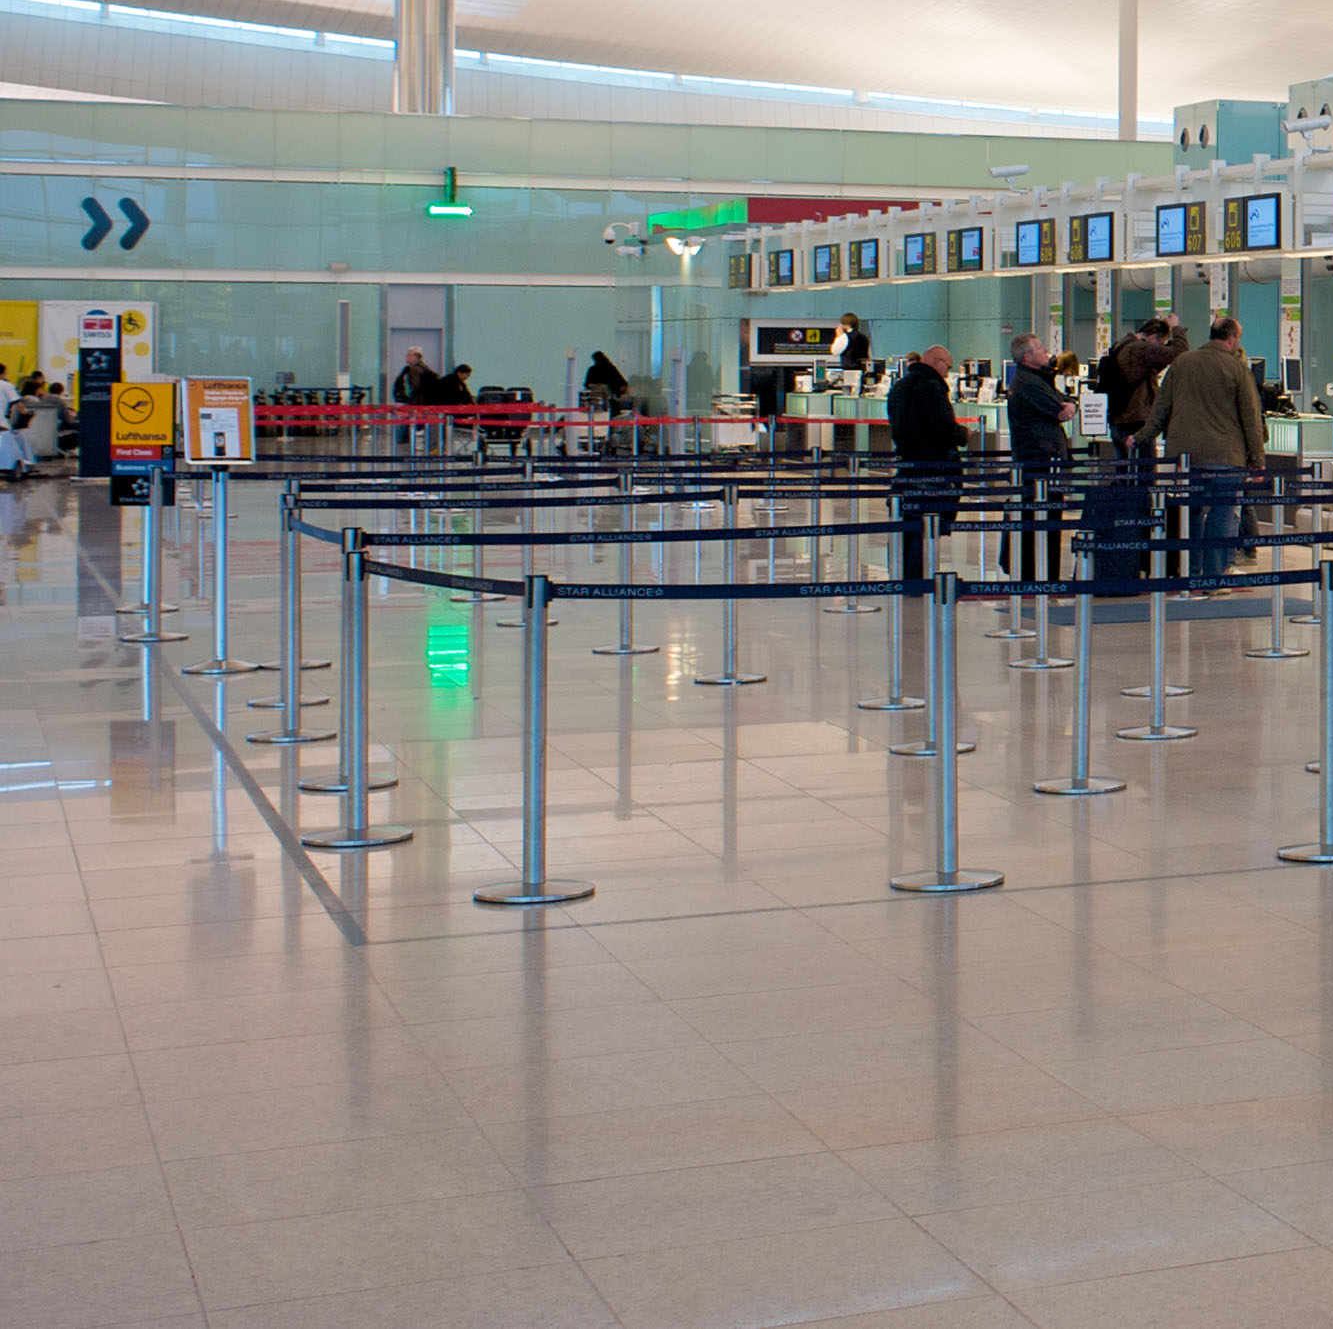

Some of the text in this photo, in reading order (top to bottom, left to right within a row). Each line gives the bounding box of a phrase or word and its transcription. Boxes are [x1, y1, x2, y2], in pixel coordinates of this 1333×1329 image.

[116, 432, 167, 441] Lufthansa
[755, 526, 827, 537] STAR ALLIANCE
[373, 536, 398, 544] STAR
[570, 533, 645, 542] STAR ALLIANCE
[1244, 534, 1308, 545] STAR ALLIANCE
[1073, 541, 1096, 549] STAR
[800, 583, 893, 595] STAR ALLIANCE
[971, 583, 1059, 593] STAR ALLIANCE
[1189, 579, 1217, 589] STAR
[557, 587, 654, 597] STAR ALLIANCE
